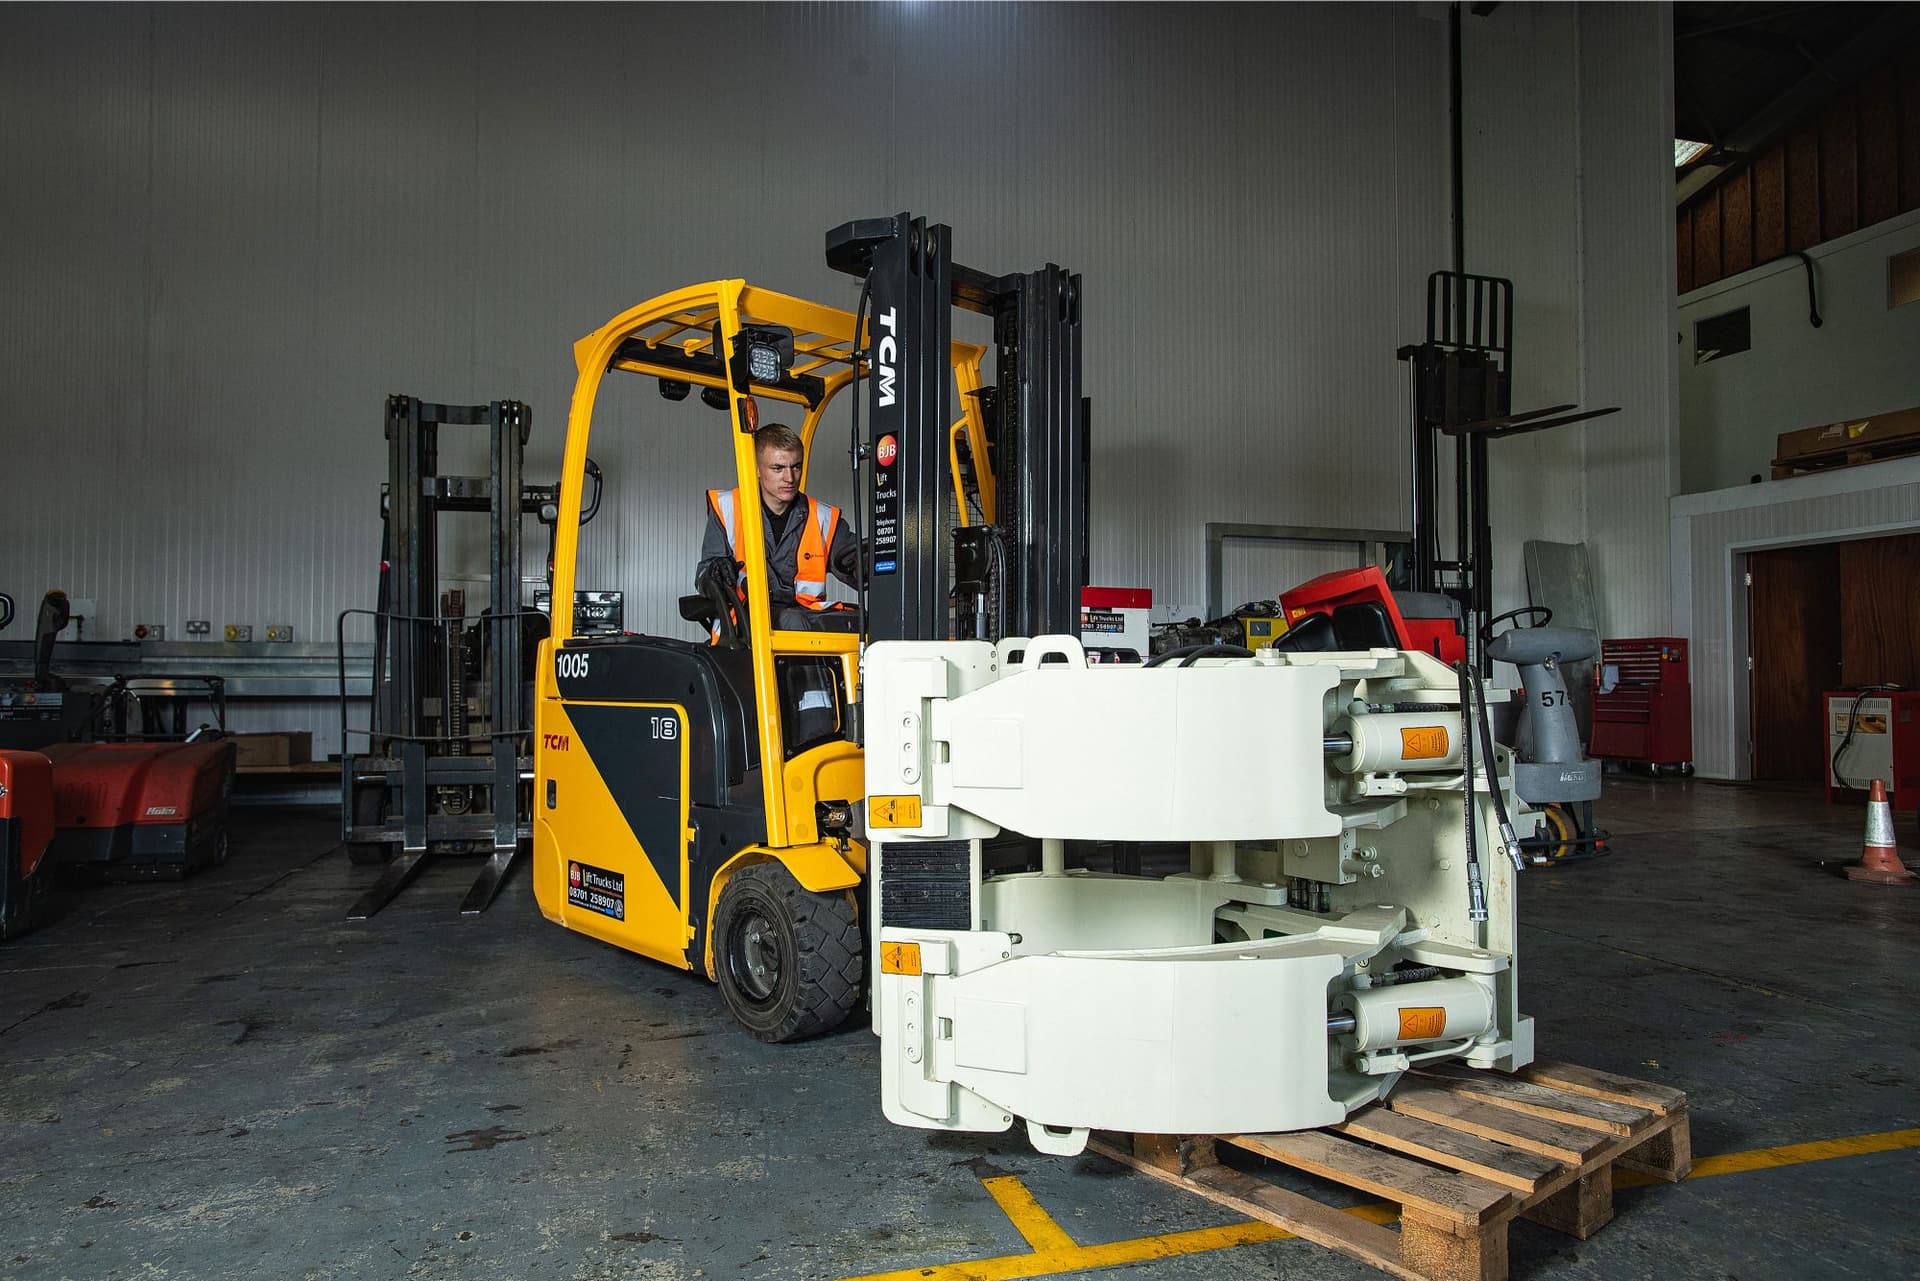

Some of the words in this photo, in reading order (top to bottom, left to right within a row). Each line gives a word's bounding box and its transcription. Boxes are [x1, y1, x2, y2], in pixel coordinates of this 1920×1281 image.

[878, 306, 897, 408] TCM
[878, 444, 896, 459] BJB
[876, 472, 888, 487] Lift
[876, 488, 897, 500] Trucks
[875, 503, 886, 513] Ltd
[876, 526, 894, 536] 08701
[875, 535, 897, 545] 258907
[557, 653, 589, 678] 1005
[1541, 690, 1565, 707] 57
[651, 717, 677, 740] 18
[543, 734, 569, 751] TCM
[570, 870, 581, 881] BJB
[583, 868, 593, 888] Lift
[593, 873, 612, 889] Trucks
[612, 879, 623, 893] Ltd
[569, 886, 588, 901] 08701
[590, 893, 615, 909] 258907
